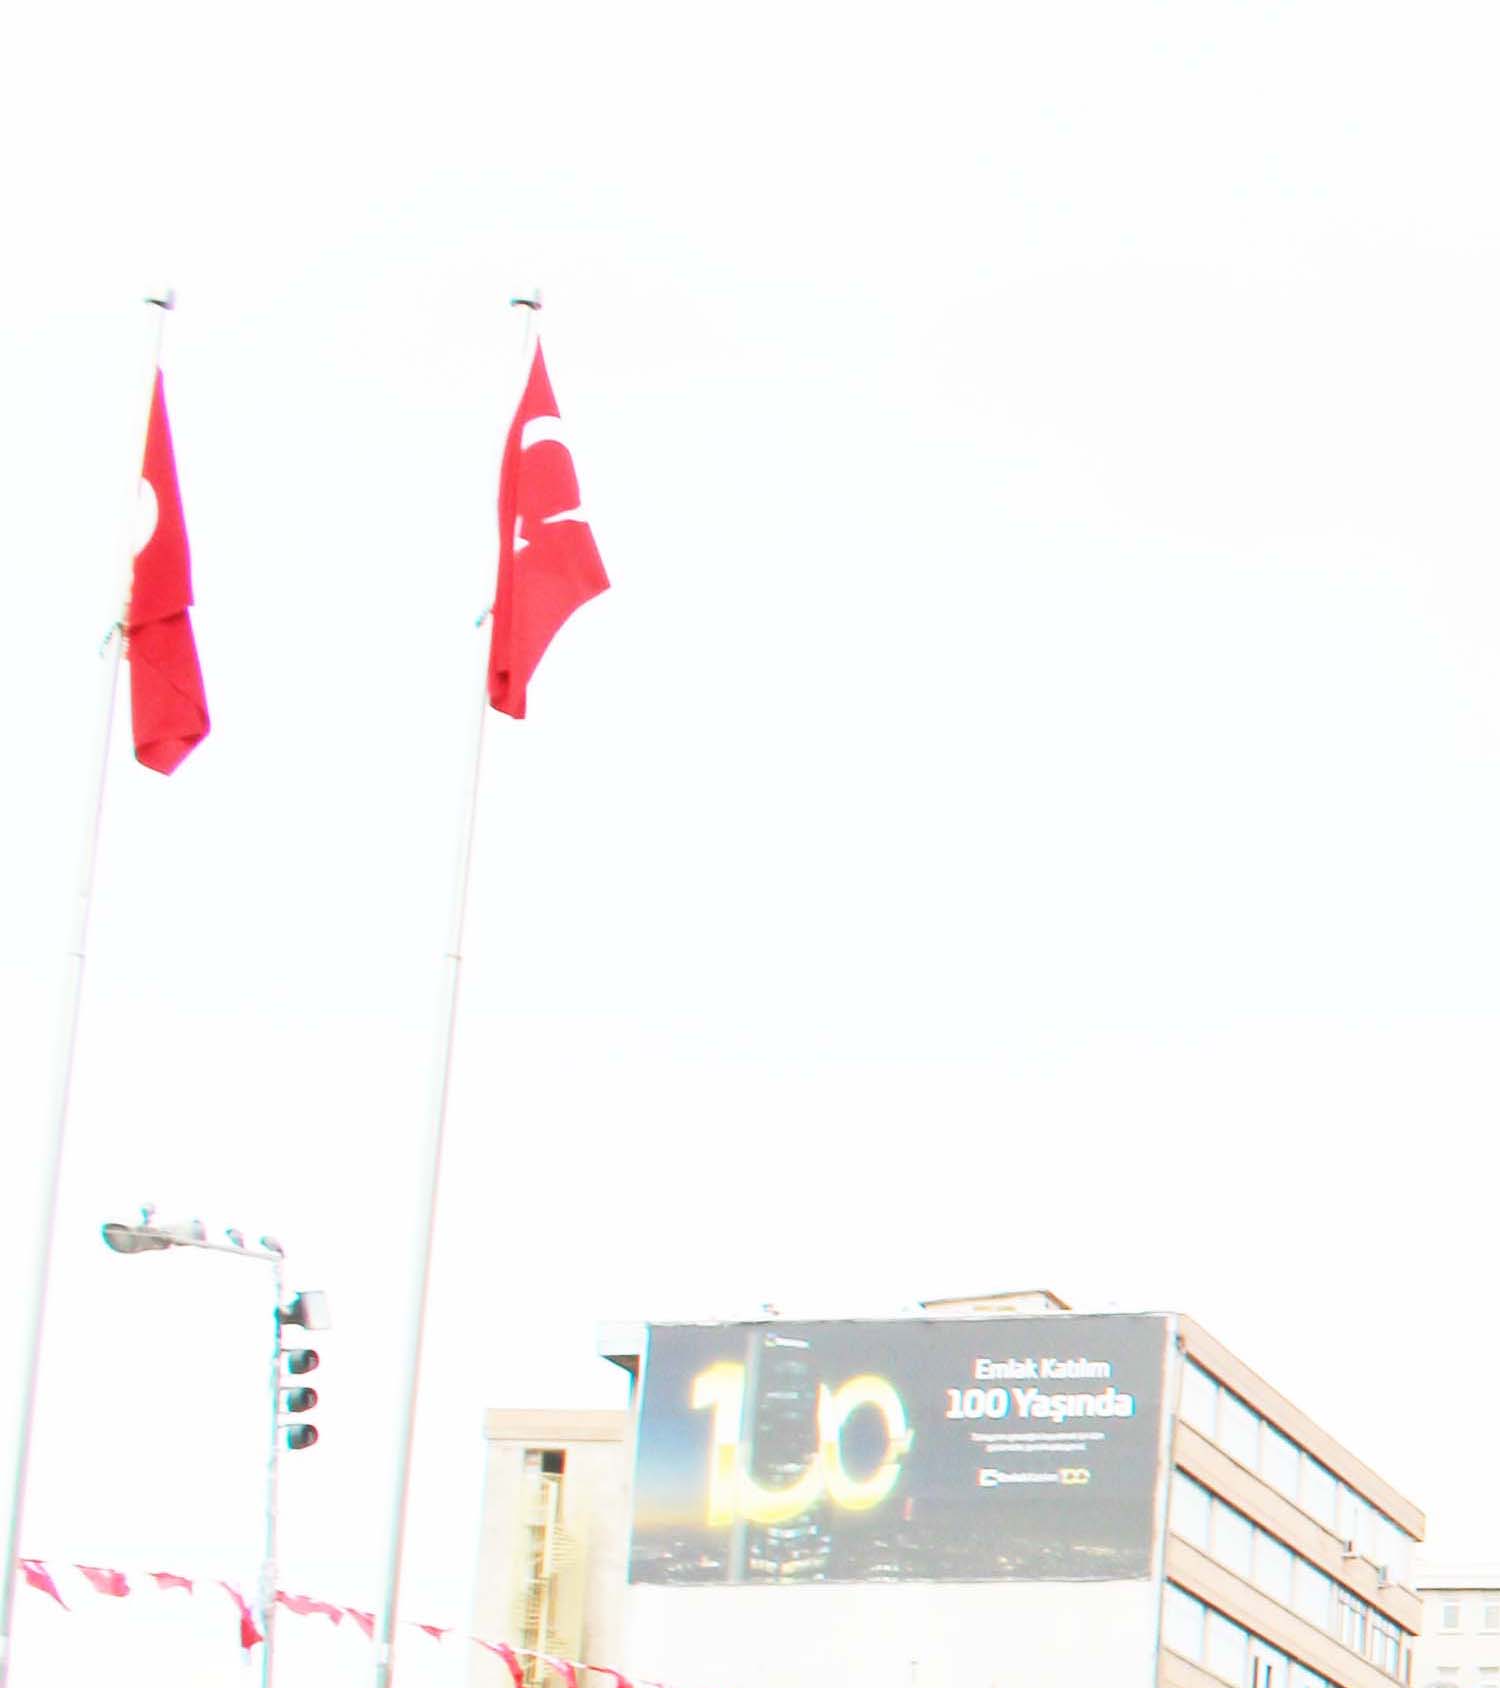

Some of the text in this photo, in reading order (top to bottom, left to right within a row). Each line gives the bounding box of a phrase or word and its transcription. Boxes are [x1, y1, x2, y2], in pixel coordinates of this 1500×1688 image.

[974, 1358, 1038, 1379] Emlak
[945, 1386, 1135, 1423] 100 Yaşında
